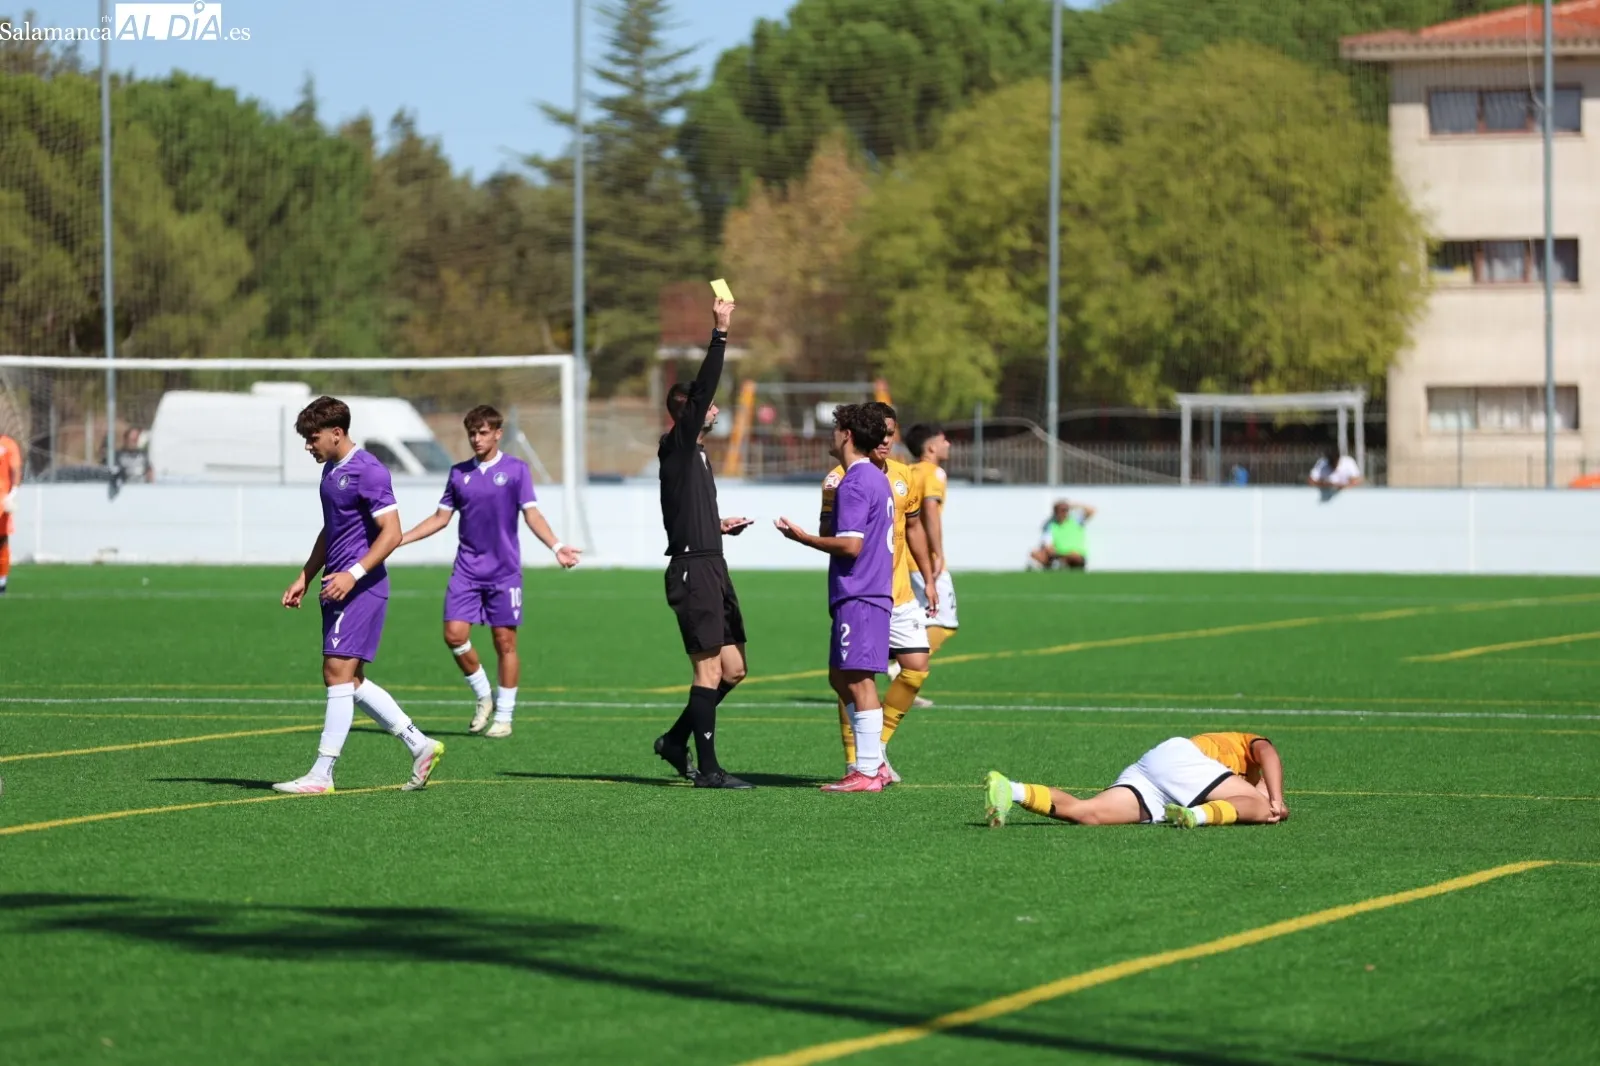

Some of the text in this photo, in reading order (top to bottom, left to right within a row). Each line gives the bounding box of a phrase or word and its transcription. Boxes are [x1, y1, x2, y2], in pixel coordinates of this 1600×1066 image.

[509, 587, 522, 608] 10
[333, 611, 345, 634] 7
[840, 623, 851, 647] 2
